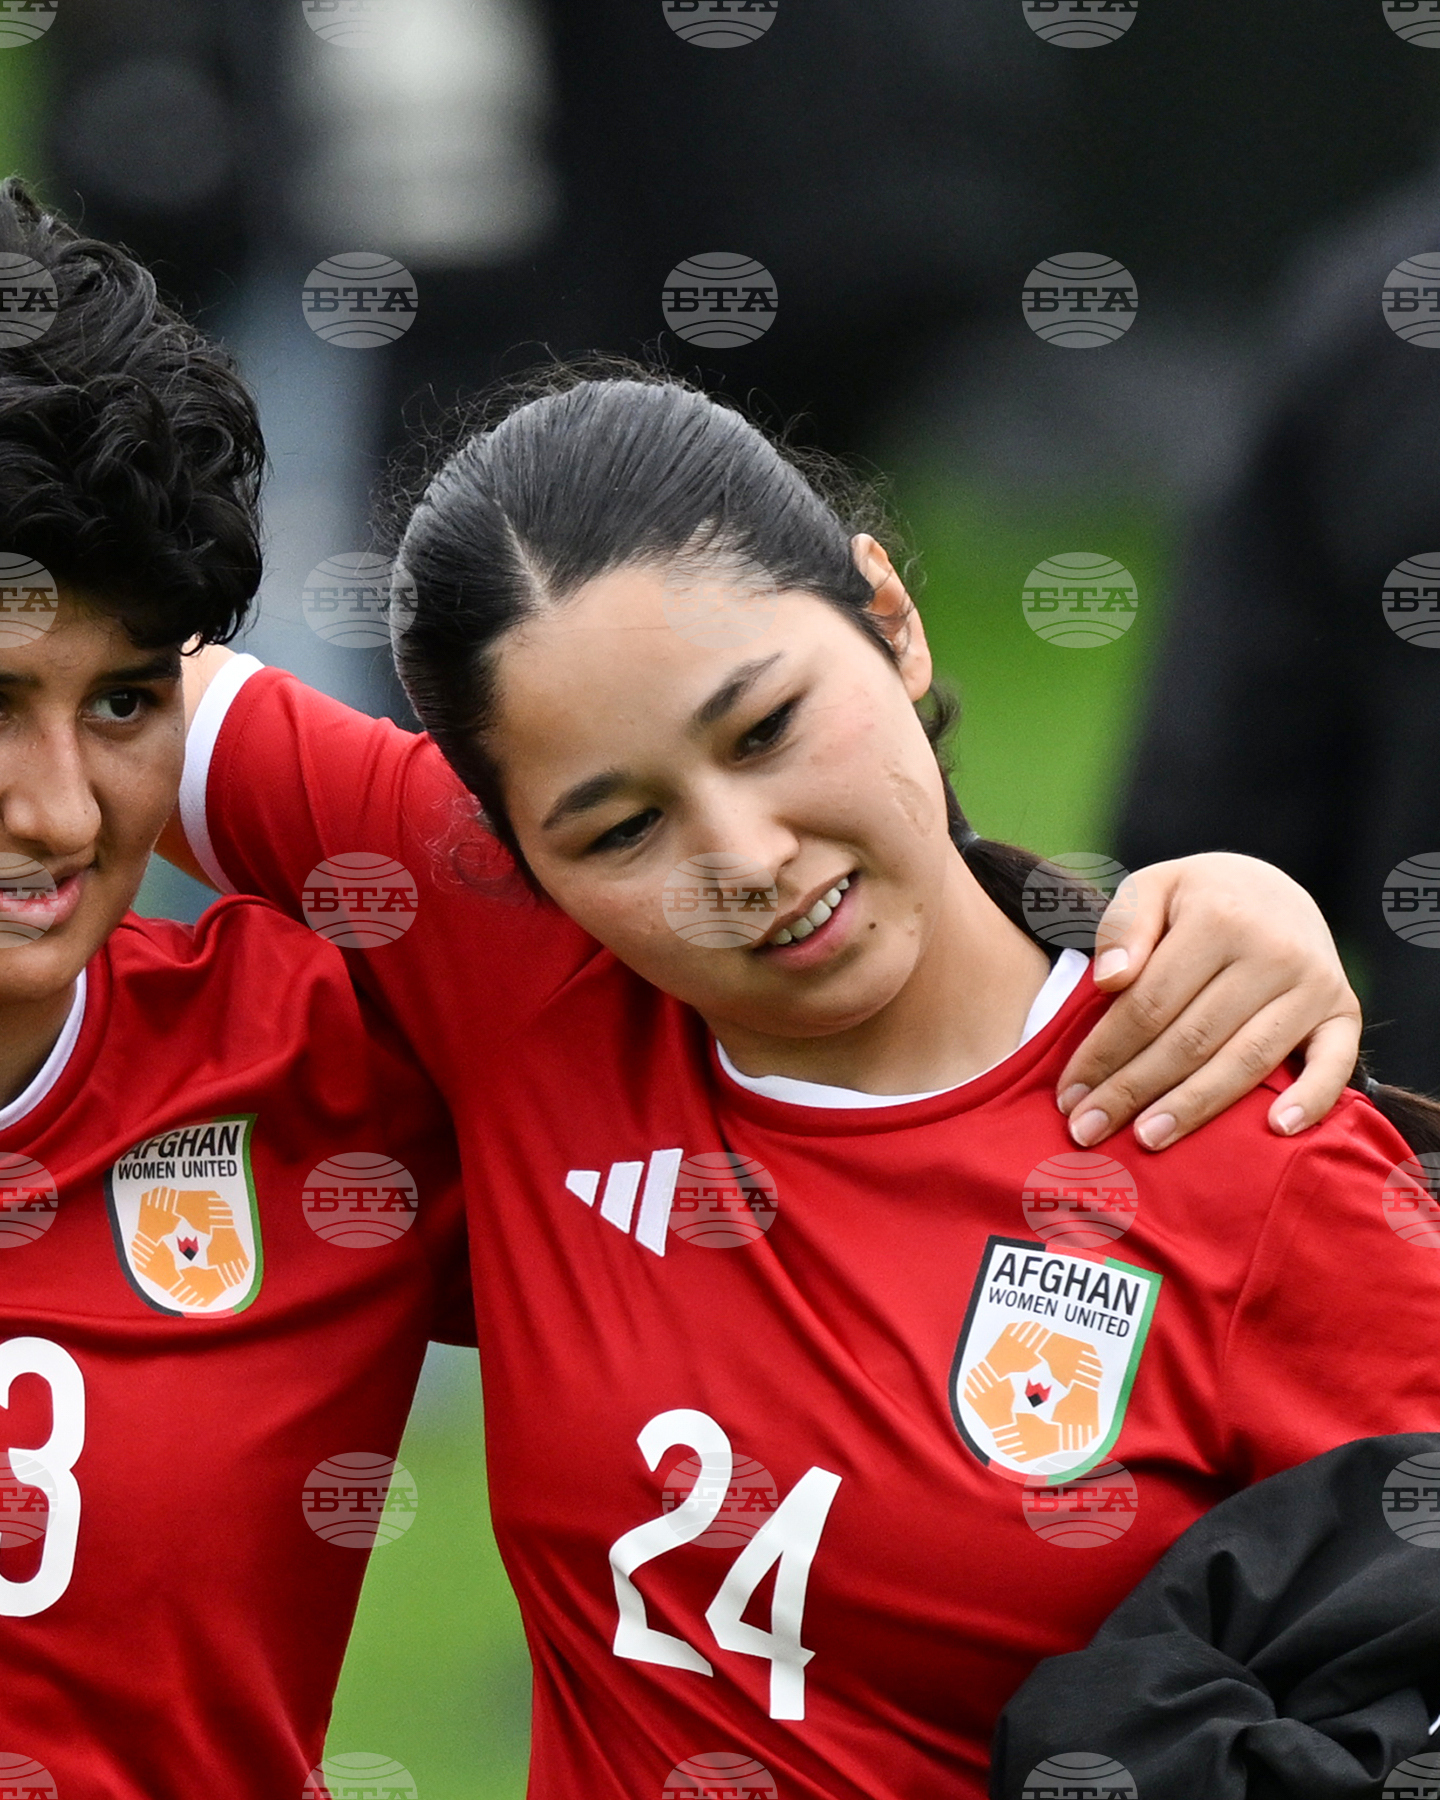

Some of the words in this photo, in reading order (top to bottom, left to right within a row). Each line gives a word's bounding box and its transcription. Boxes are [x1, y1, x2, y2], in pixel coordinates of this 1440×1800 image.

[122, 1125, 240, 1161] AFGHAN
[118, 1161, 176, 1180] WOMEN
[182, 1159, 238, 1178] UNITED
[992, 1252, 1141, 1317] AFGHAN
[988, 1286, 1059, 1317] WOMEN
[1064, 1303, 1131, 1338] UNITED
[608, 1409, 843, 1721] 24
